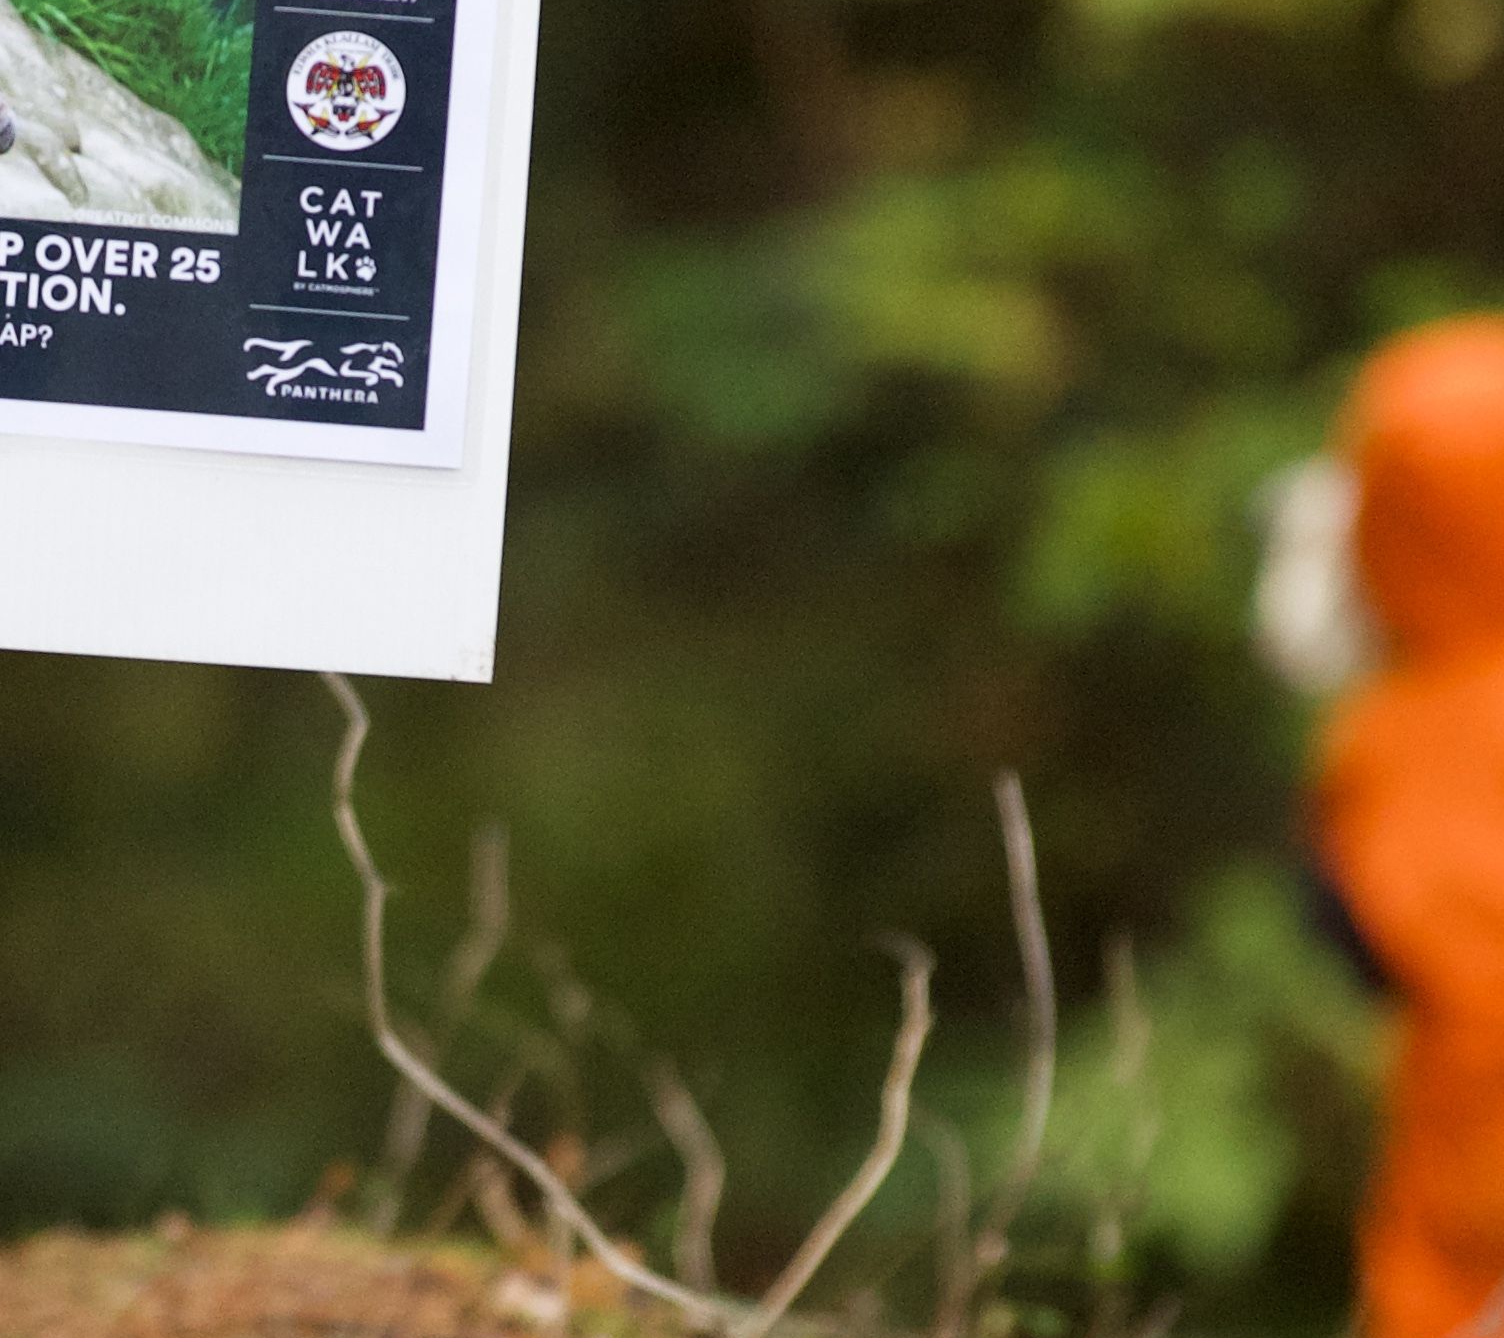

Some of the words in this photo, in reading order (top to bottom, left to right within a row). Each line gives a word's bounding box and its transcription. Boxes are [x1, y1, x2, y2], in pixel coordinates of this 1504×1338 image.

[300, 186, 382, 218] CAT
[149, 212, 235, 234] COMMONS
[36, 235, 158, 278] OVER
[170, 247, 220, 283] 25
[281, 385, 379, 404] PANTHERA
